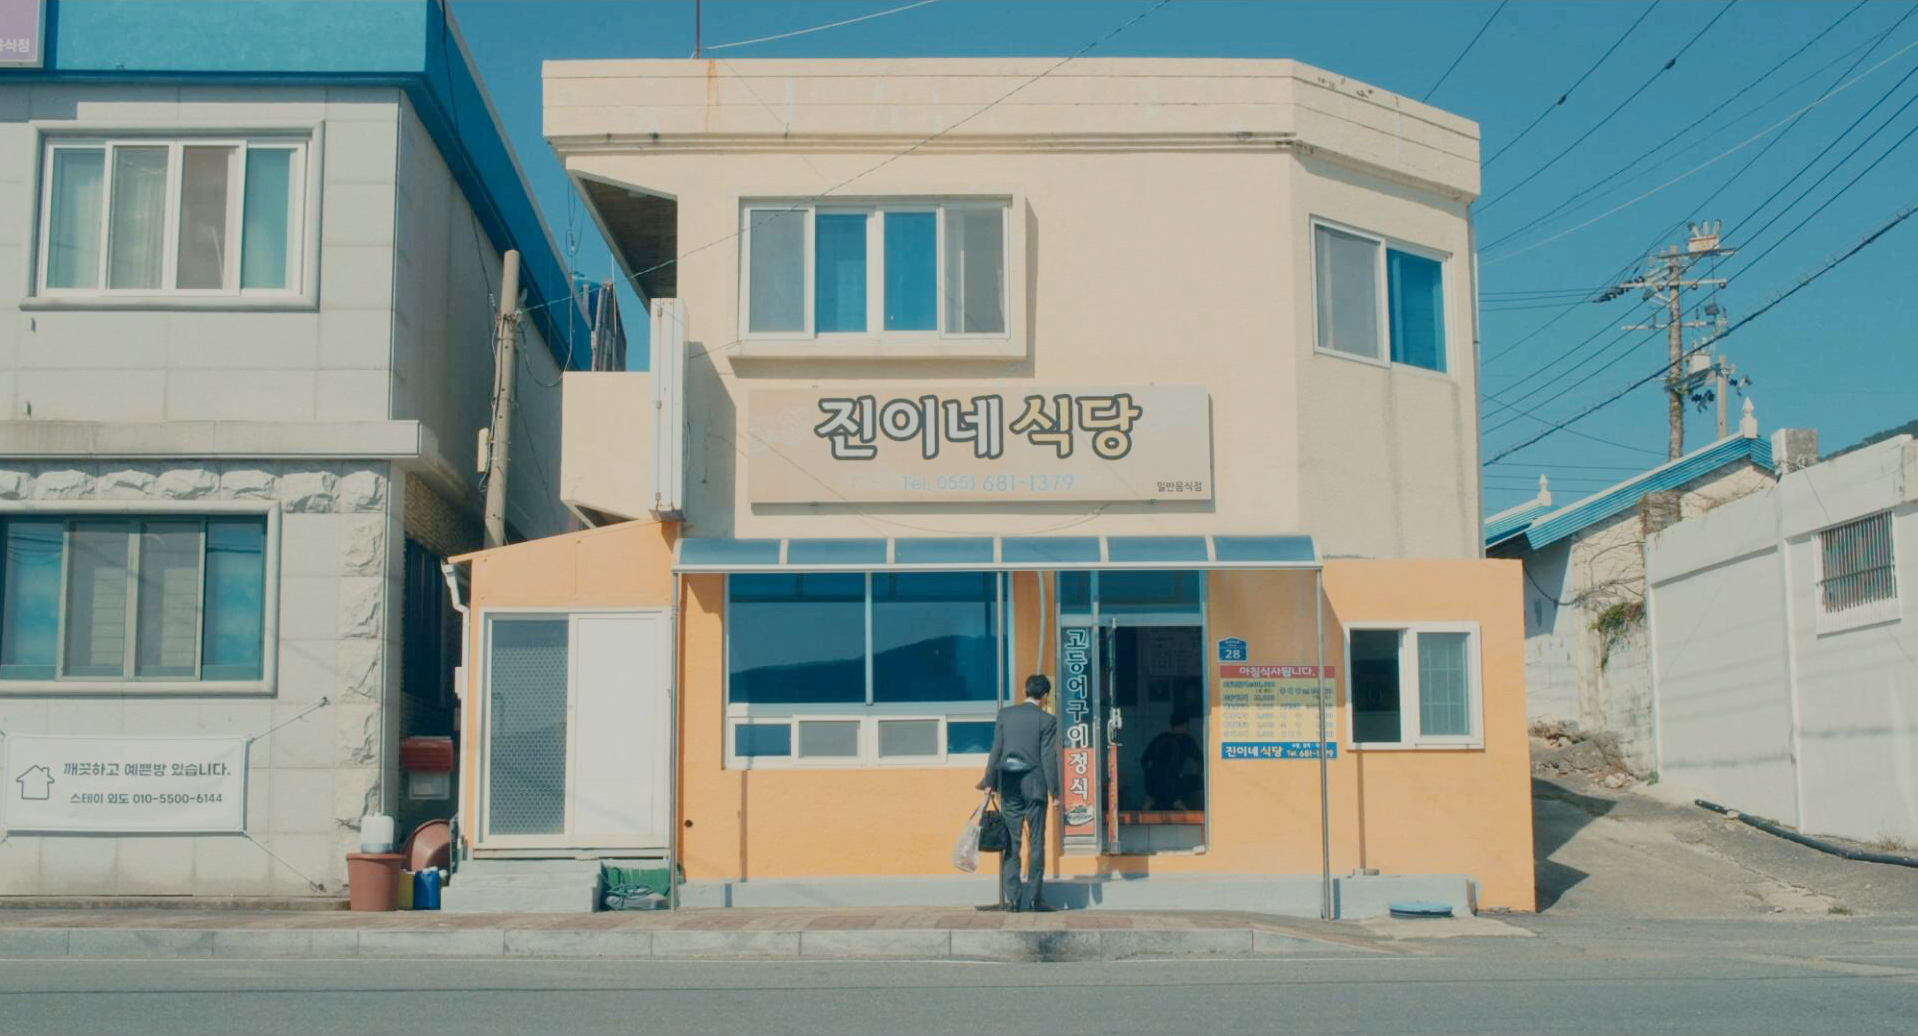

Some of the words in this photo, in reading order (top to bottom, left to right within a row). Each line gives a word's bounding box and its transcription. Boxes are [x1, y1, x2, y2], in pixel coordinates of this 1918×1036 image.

[0, 38, 30, 52] 식점
[813, 394, 1004, 460] 진이네
[1009, 393, 1143, 460] 식당
[982, 474, 1074, 491] 681-1379
[1156, 481, 1203, 493] 일반음식점
[1225, 649, 1241, 659] 28
[1064, 629, 1089, 749] 고등어구이
[1225, 745, 1259, 758] 진이네
[1260, 745, 1284, 758] 식당
[63, 762, 119, 777] 깨끗하고
[124, 762, 168, 777] 예쁜방
[171, 762, 232, 776] 있습니다.
[1070, 750, 1088, 801] 정식
[70, 793, 104, 804] 스테이
[107, 793, 130, 804] 외도
[133, 793, 223, 804] 010-5500-6144
